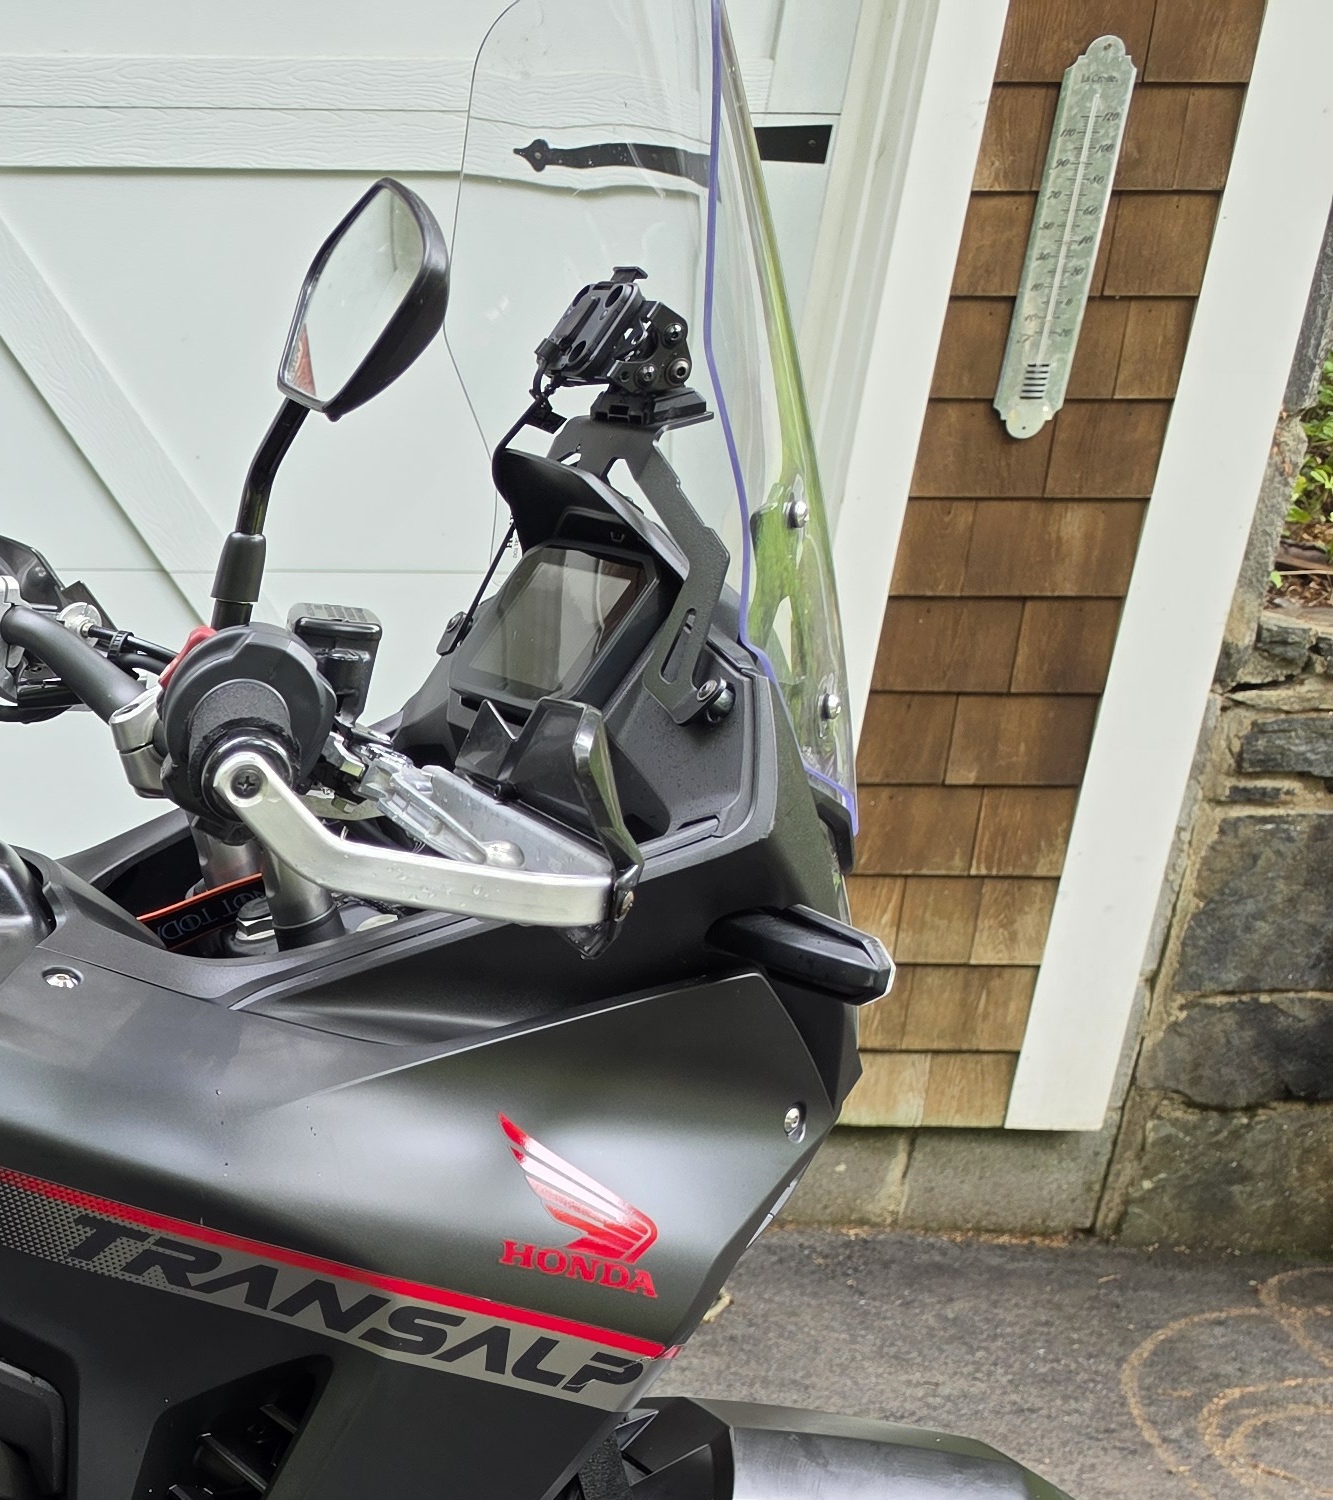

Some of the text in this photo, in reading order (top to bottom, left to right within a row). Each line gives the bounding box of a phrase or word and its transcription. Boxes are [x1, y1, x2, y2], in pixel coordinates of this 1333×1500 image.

[157, 908, 219, 940] TOD
[500, 1238, 659, 1298] HONDA
[66, 1217, 646, 1392] TRANSALP
